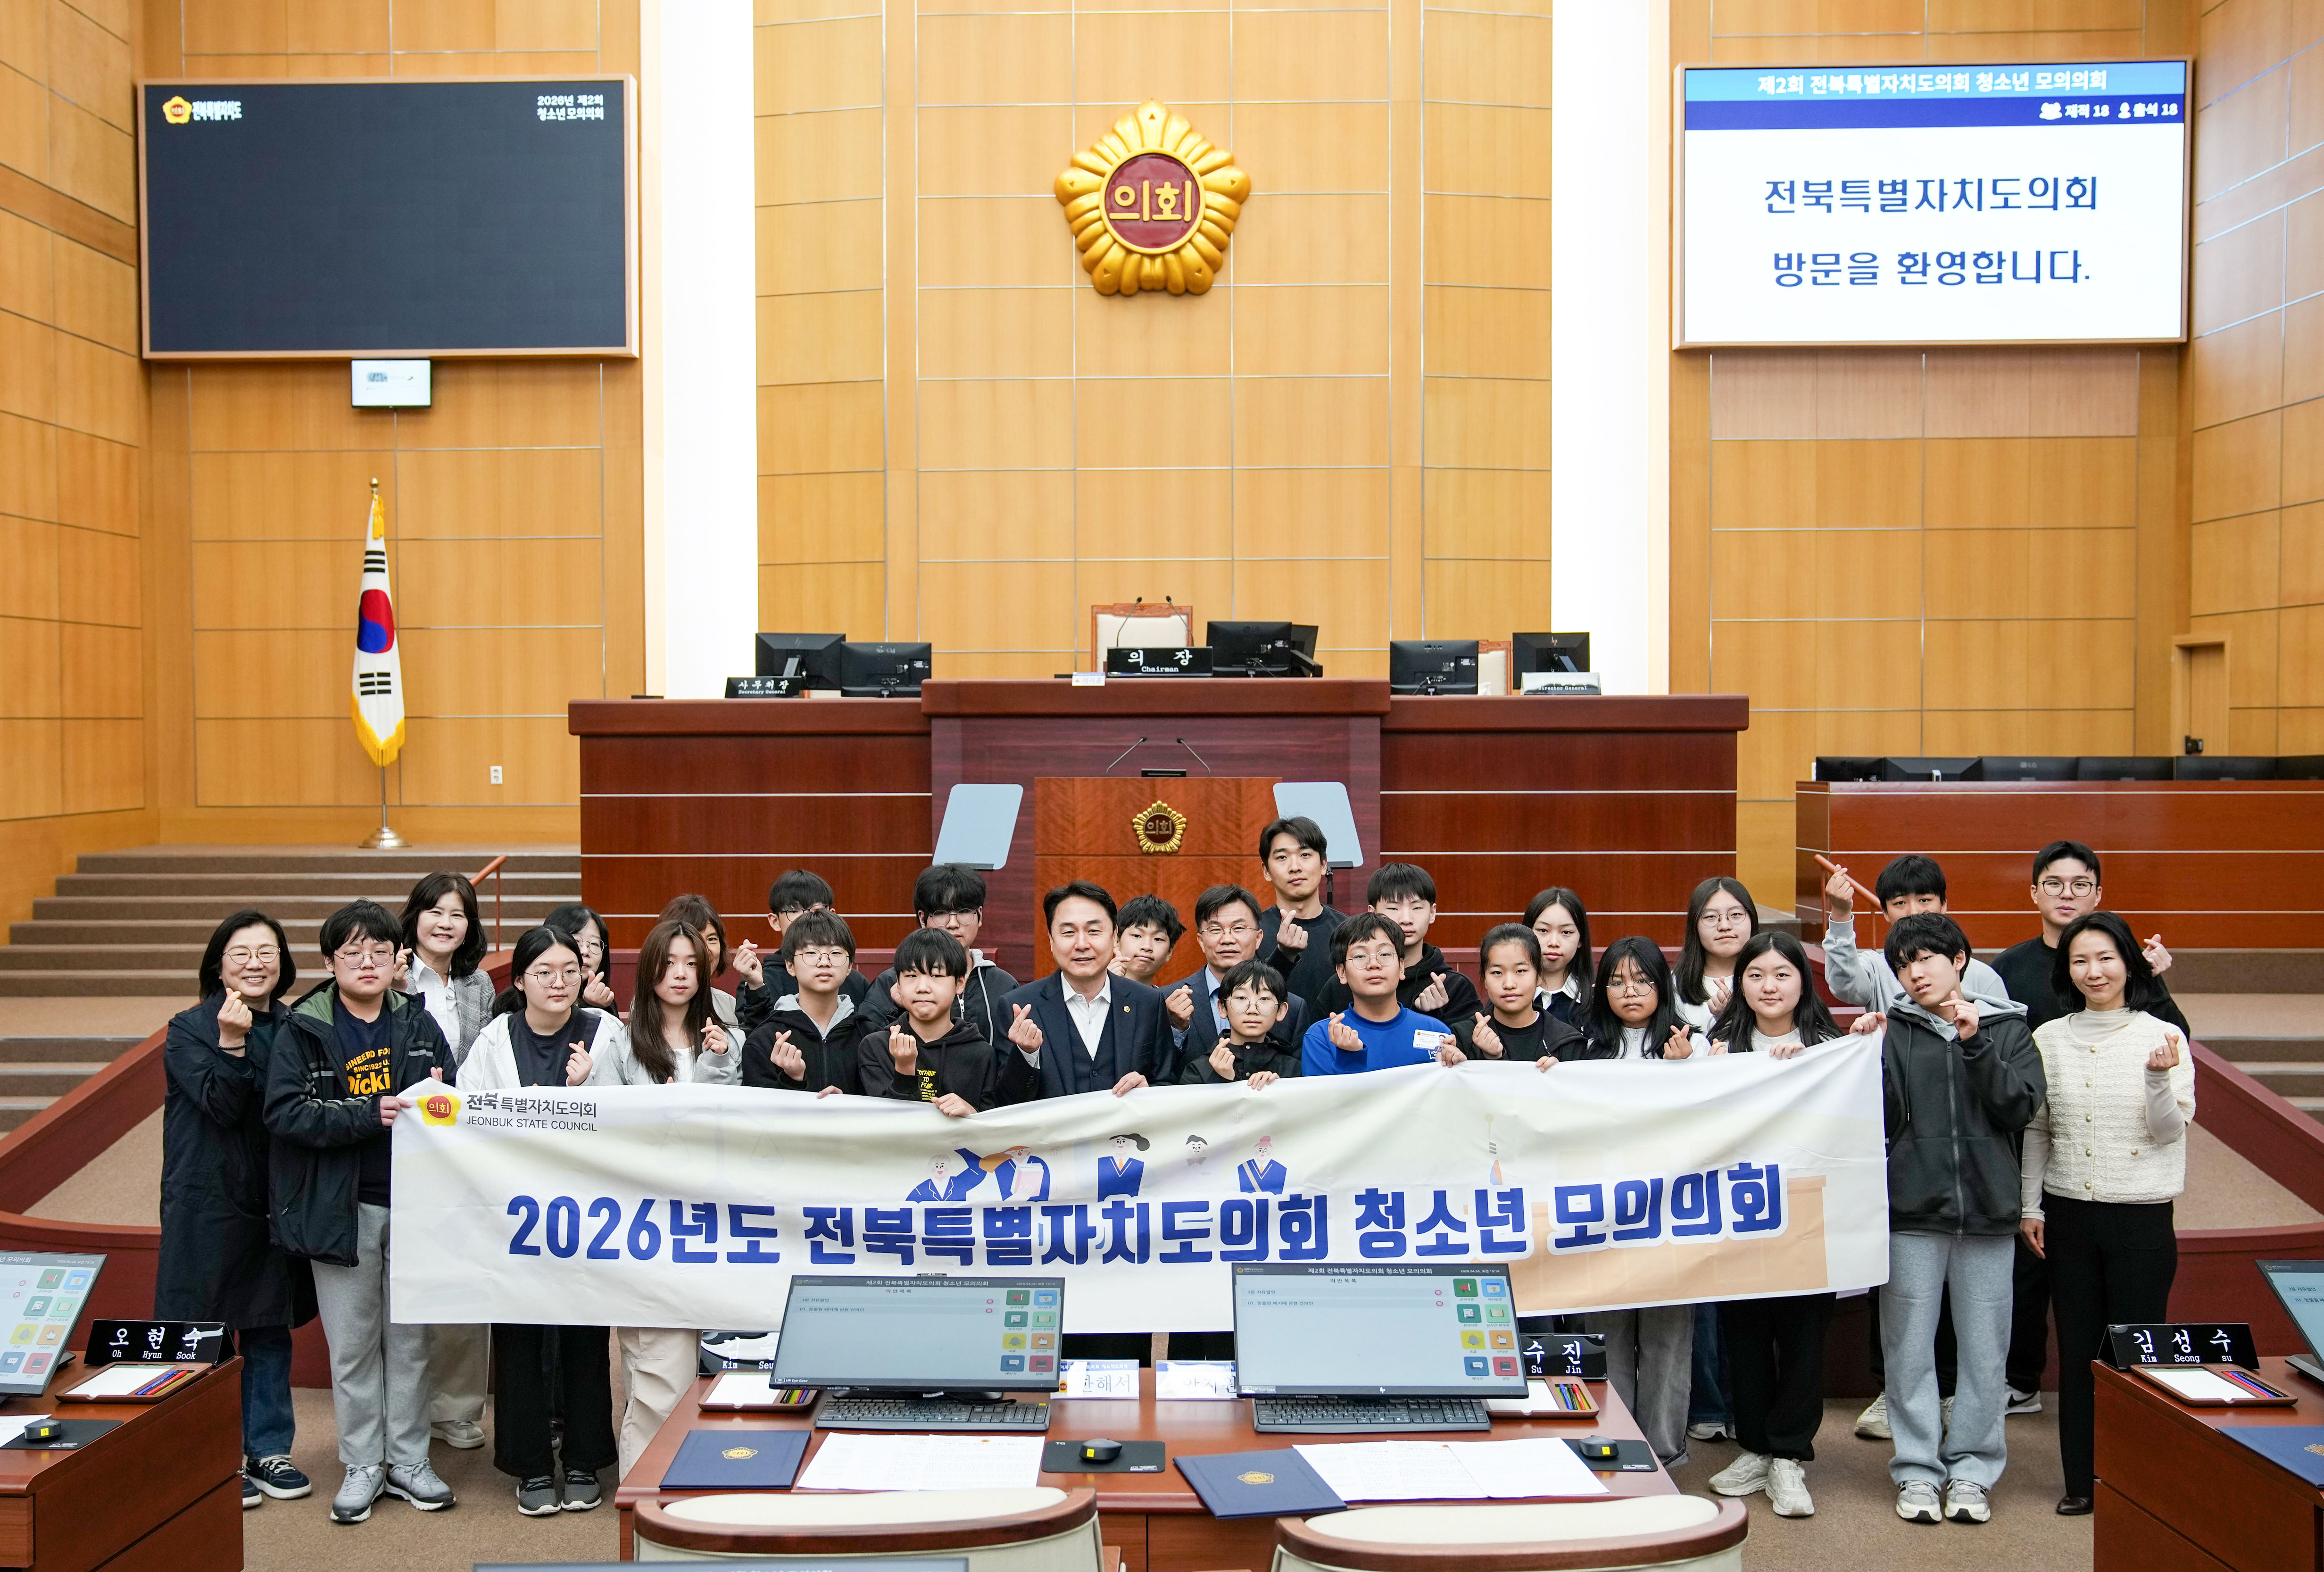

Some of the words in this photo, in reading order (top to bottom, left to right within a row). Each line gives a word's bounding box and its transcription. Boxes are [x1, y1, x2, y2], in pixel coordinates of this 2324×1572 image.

[1758, 75, 1804, 95] 제2회
[1810, 73, 1970, 94] 전북특별자치도의회
[1976, 71, 2029, 92] 청소년
[2035, 70, 2107, 91] 모의의회
[537, 94, 574, 106] 2026년
[577, 94, 604, 106] 제2회
[537, 107, 566, 121] 청소년
[566, 107, 604, 121] 모의의회
[2093, 104, 2109, 117] 18
[2161, 103, 2178, 116] 18
[1109, 180, 1192, 222] 의회
[1764, 176, 2097, 214] 전북특별자치도의회
[1773, 250, 1879, 288] 방문을
[1896, 250, 2090, 286] 환영합니다.
[1145, 820, 1172, 835] 의회
[377, 1047, 390, 1057] FO
[428, 1102, 450, 1115] 의회
[466, 1092, 499, 1110] 전북
[500, 1097, 597, 1118] 특별자치도의회
[466, 1116, 513, 1127] JEONBUK
[516, 1118, 548, 1129] STATE
[551, 1121, 598, 1131] COUNCIL
[506, 1196, 780, 1264] 2026년도
[803, 1193, 1328, 1266] 전북특별자치도의회
[1355, 1188, 1527, 1258] 청소년
[1554, 1162, 1782, 1249] 모의의회
[112, 1349, 122, 1358] Oh
[142, 1350, 162, 1359] Hyun
[176, 1351, 196, 1360] Sook
[2141, 1354, 2158, 1363] Kim
[2174, 1354, 2200, 1363] Seong
[722, 1361, 738, 1369] Kim
[1531, 1365, 1542, 1374] Su
[1566, 1365, 1582, 1374] Jin
